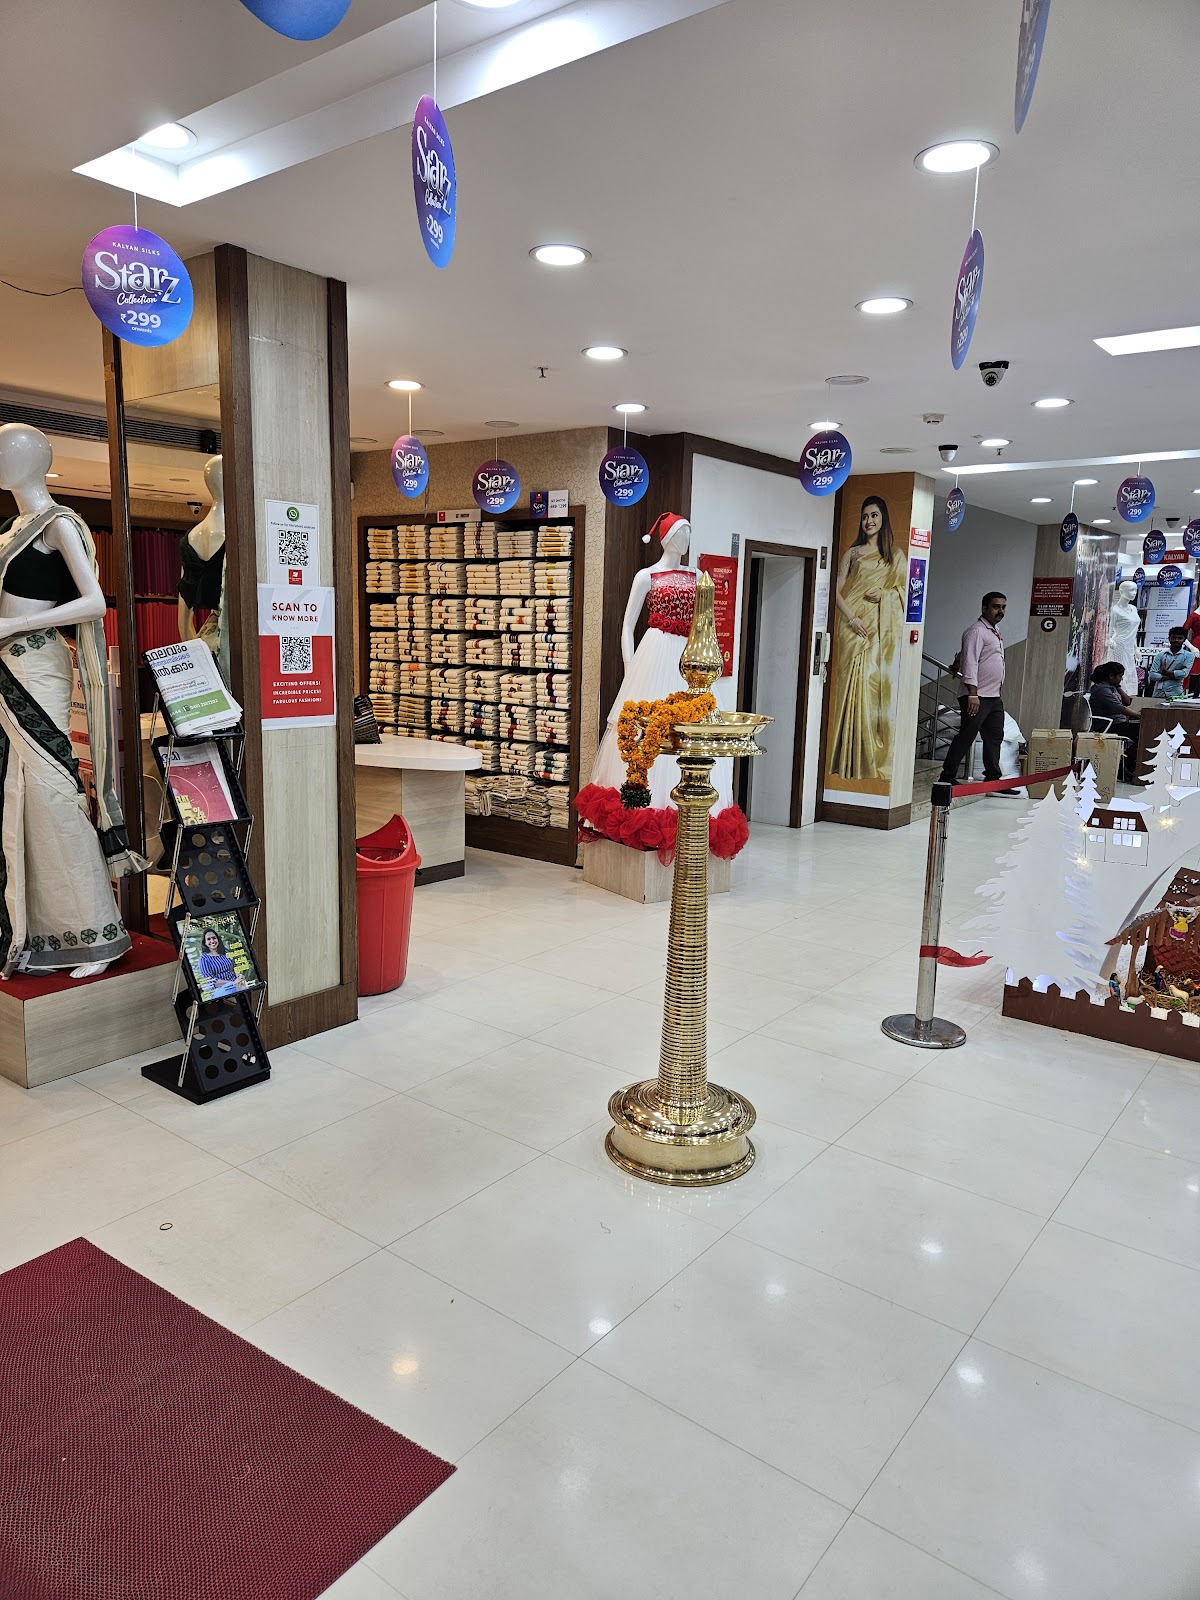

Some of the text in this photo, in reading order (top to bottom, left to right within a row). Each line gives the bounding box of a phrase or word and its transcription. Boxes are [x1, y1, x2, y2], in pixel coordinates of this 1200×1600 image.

[112, 241, 161, 256] KALYAN SILKS
[116, 292, 158, 305] Collection
[272, 602, 317, 612] SCAN TO
[1043, 620, 1054, 630] G
